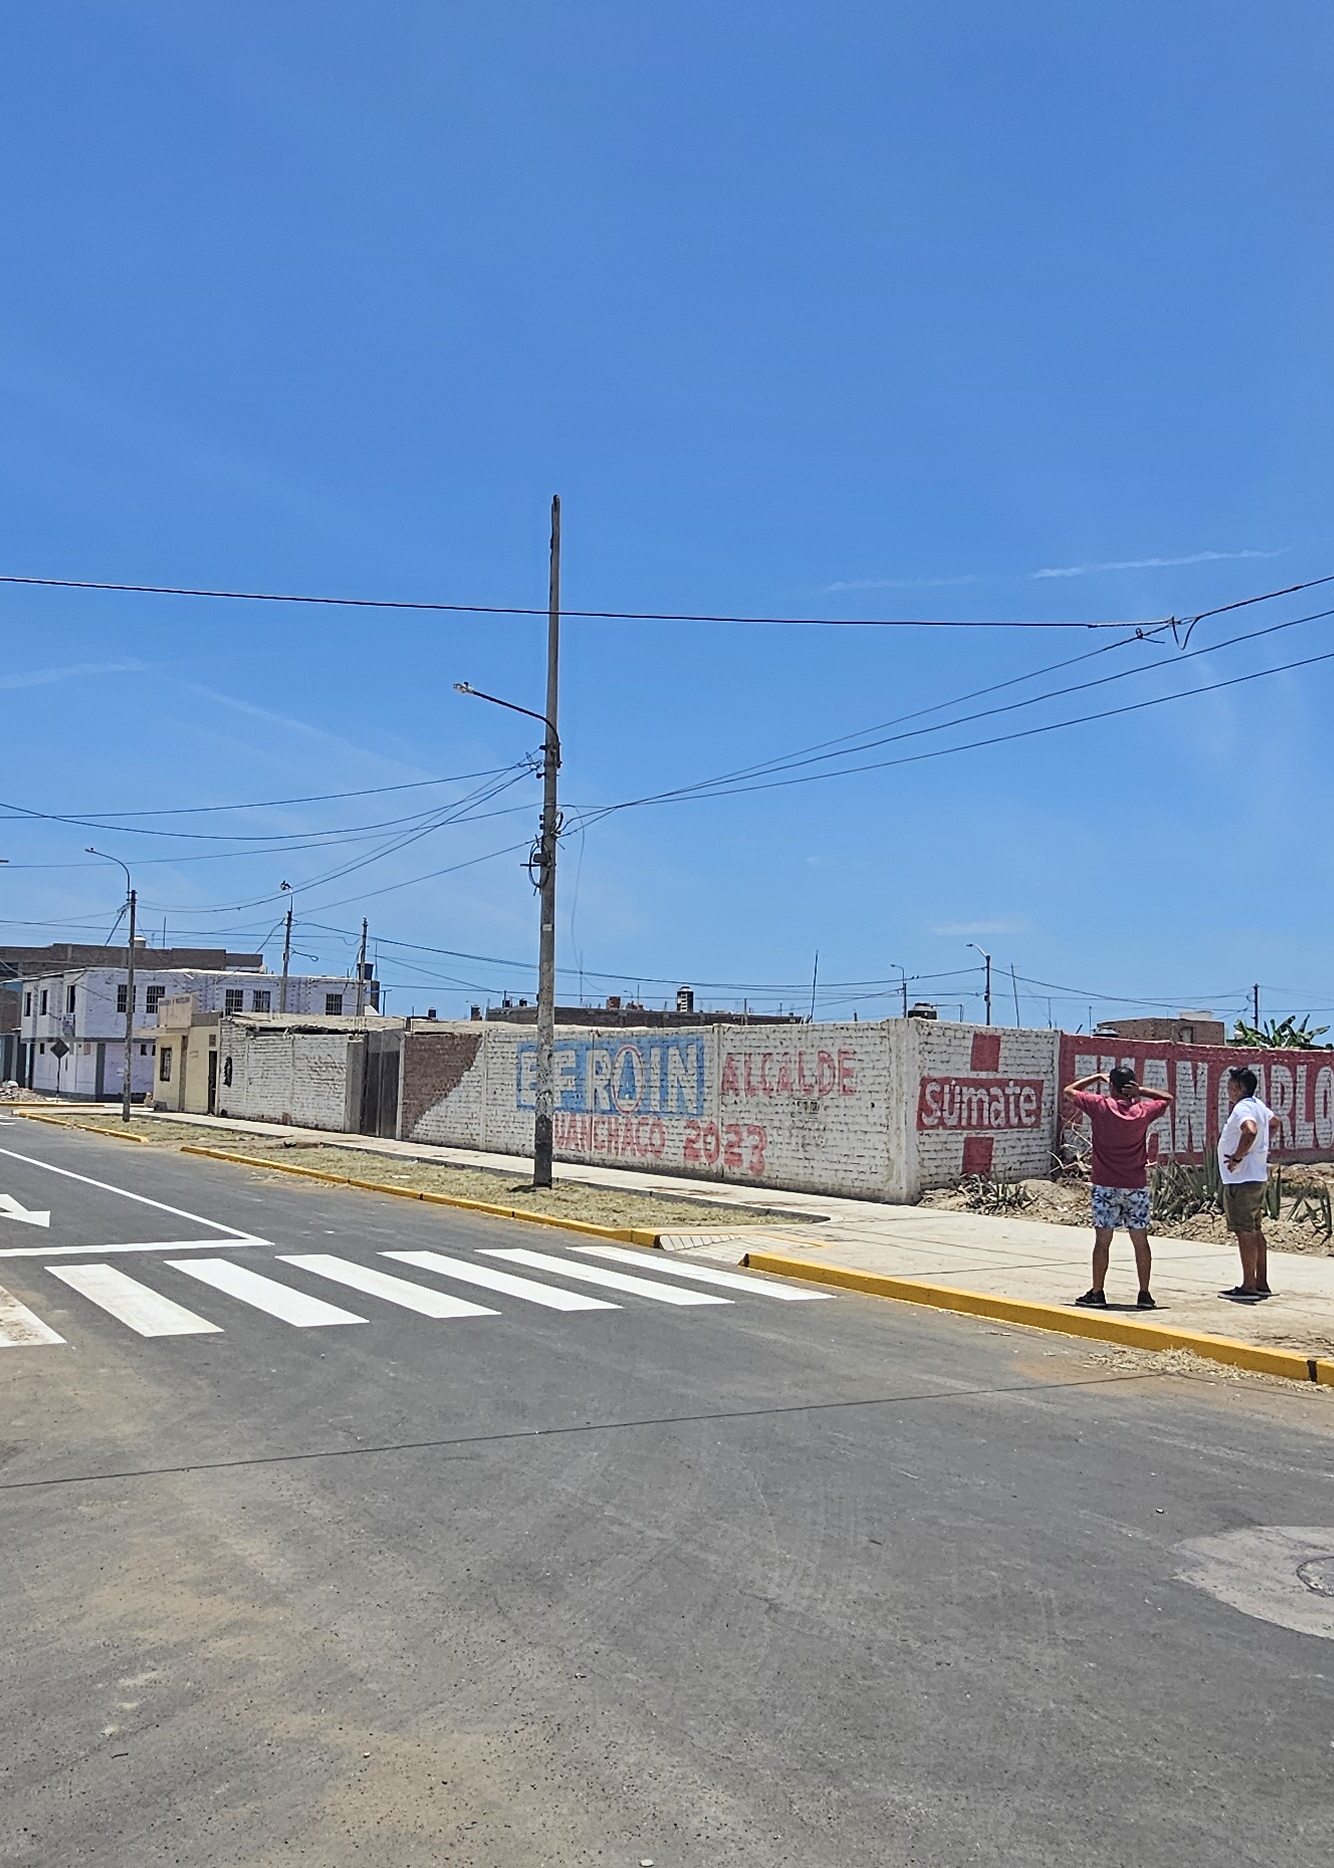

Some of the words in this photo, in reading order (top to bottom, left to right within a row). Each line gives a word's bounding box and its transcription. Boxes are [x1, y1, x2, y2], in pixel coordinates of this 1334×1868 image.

[721, 1049, 856, 1097] ALCALDE
[553, 1112, 666, 1159] UANCHACO
[683, 1117, 767, 1177] 2023
